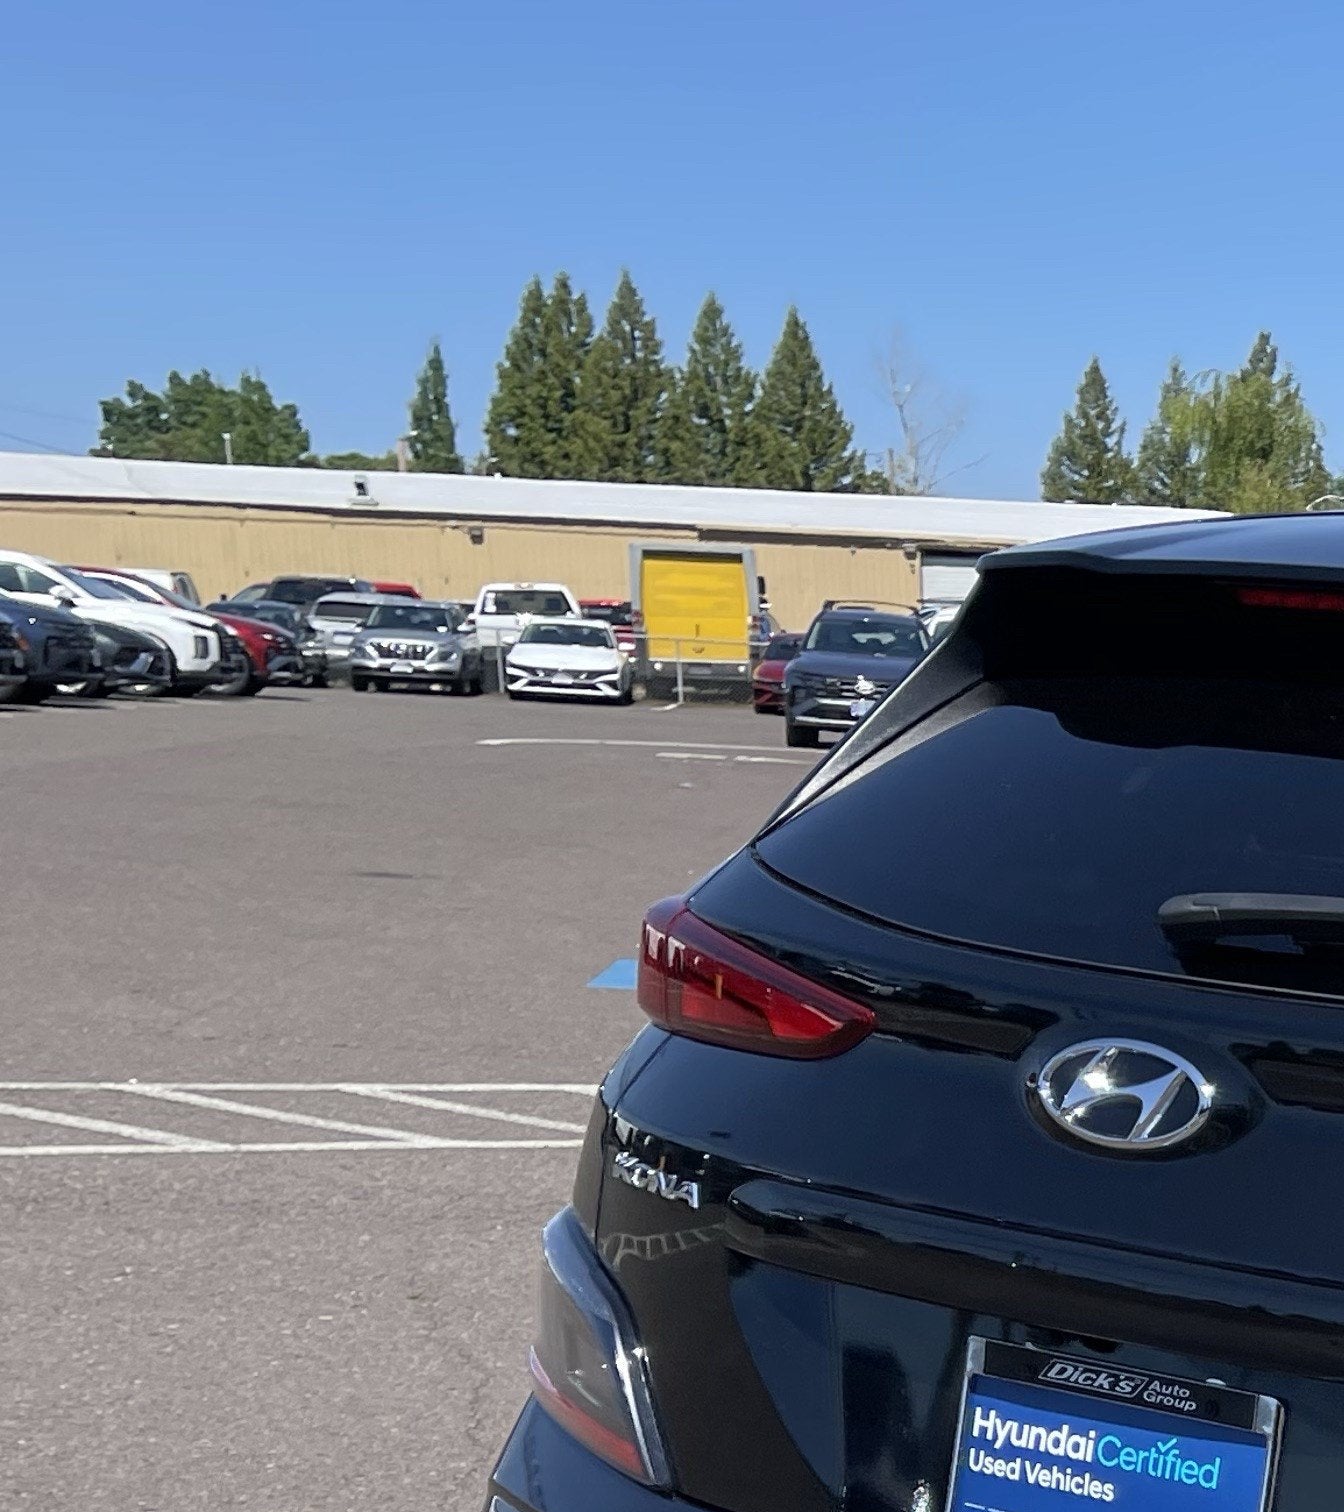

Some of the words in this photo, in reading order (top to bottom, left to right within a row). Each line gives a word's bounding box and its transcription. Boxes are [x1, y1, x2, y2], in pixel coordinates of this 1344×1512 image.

[1046, 1362, 1136, 1394] Dick's
[1148, 1379, 1191, 1398] Auto
[1142, 1390, 1198, 1412] Group
[967, 1447, 1021, 1482] Used
[1024, 1459, 1116, 1502] Vehicles
